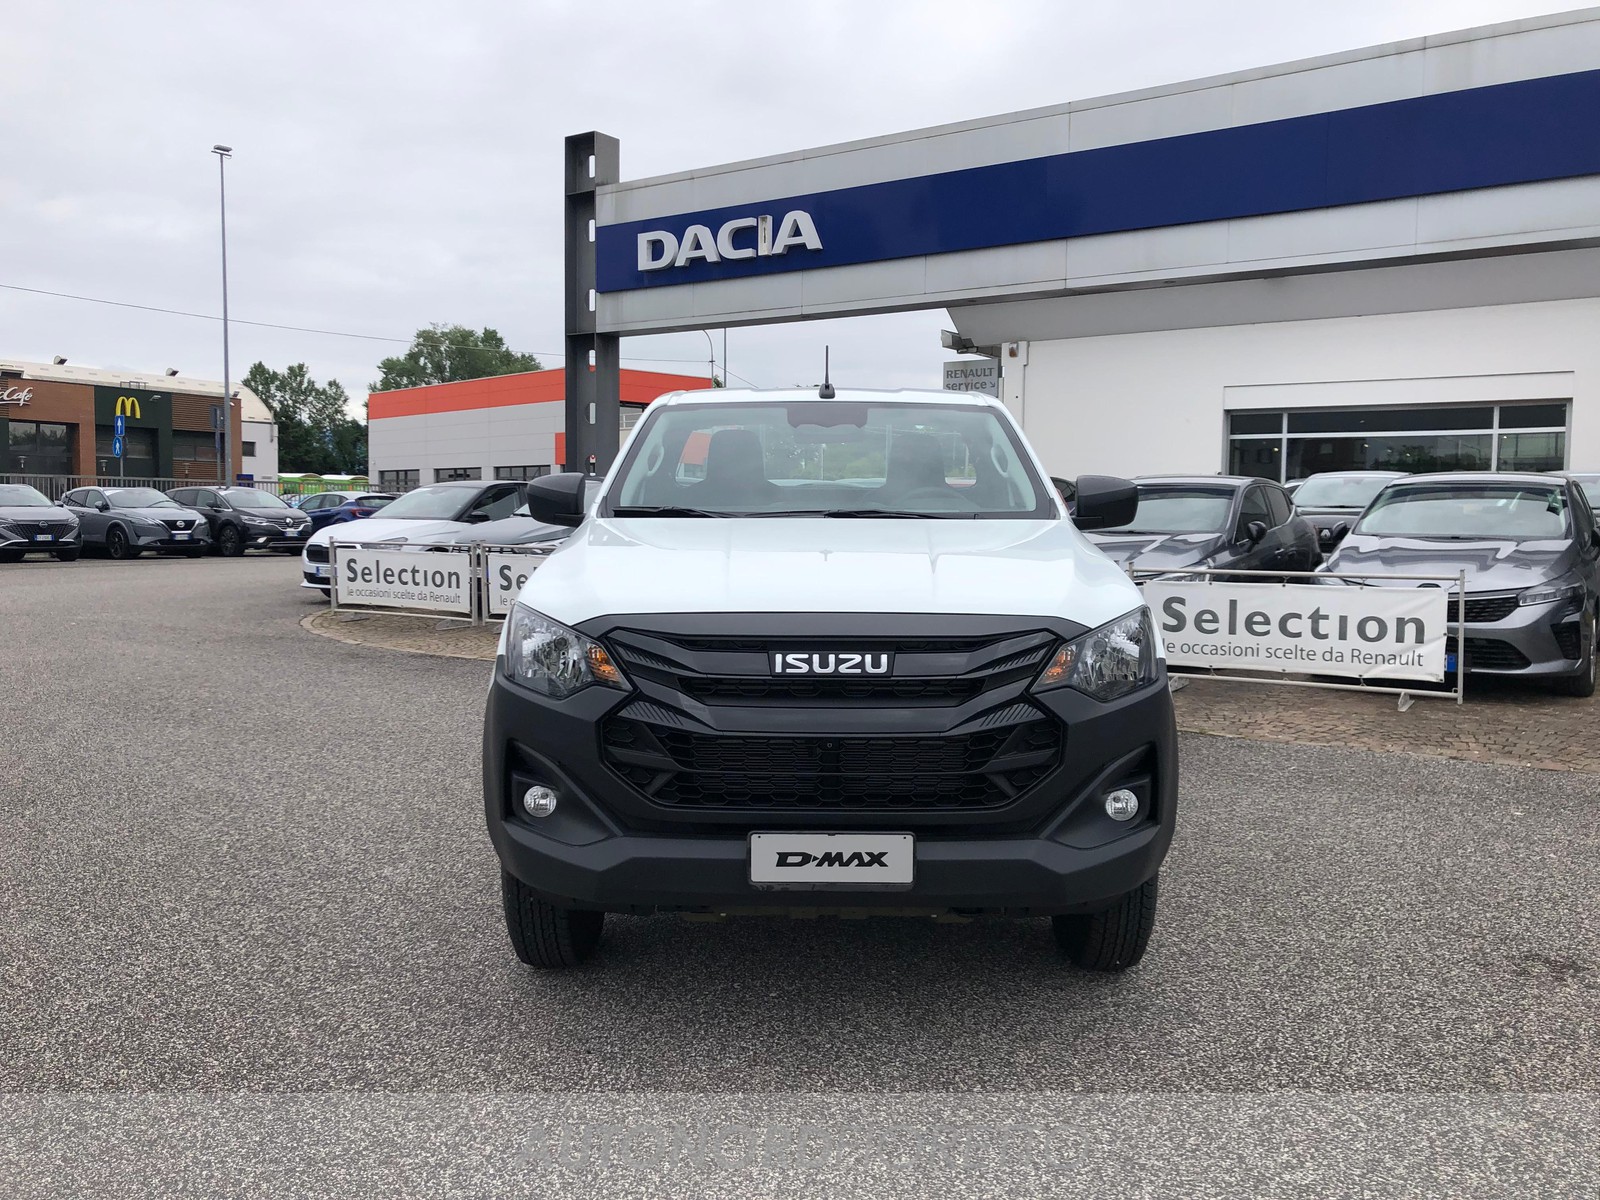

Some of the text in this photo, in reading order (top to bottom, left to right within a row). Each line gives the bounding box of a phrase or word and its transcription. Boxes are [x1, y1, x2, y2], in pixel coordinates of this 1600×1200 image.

[637, 210, 823, 271] DACIA
[946, 367, 995, 379] RENAULT
[945, 379, 987, 392] service
[346, 558, 460, 589] Selection
[346, 586, 461, 604] le occasioni scelte da Renault
[1162, 596, 1425, 644] Selection
[775, 653, 888, 674] ISUZU
[1180, 640, 1260, 658] occasioni
[1265, 644, 1316, 661] scelte
[1322, 646, 1344, 663] da
[1350, 648, 1424, 667] Renault
